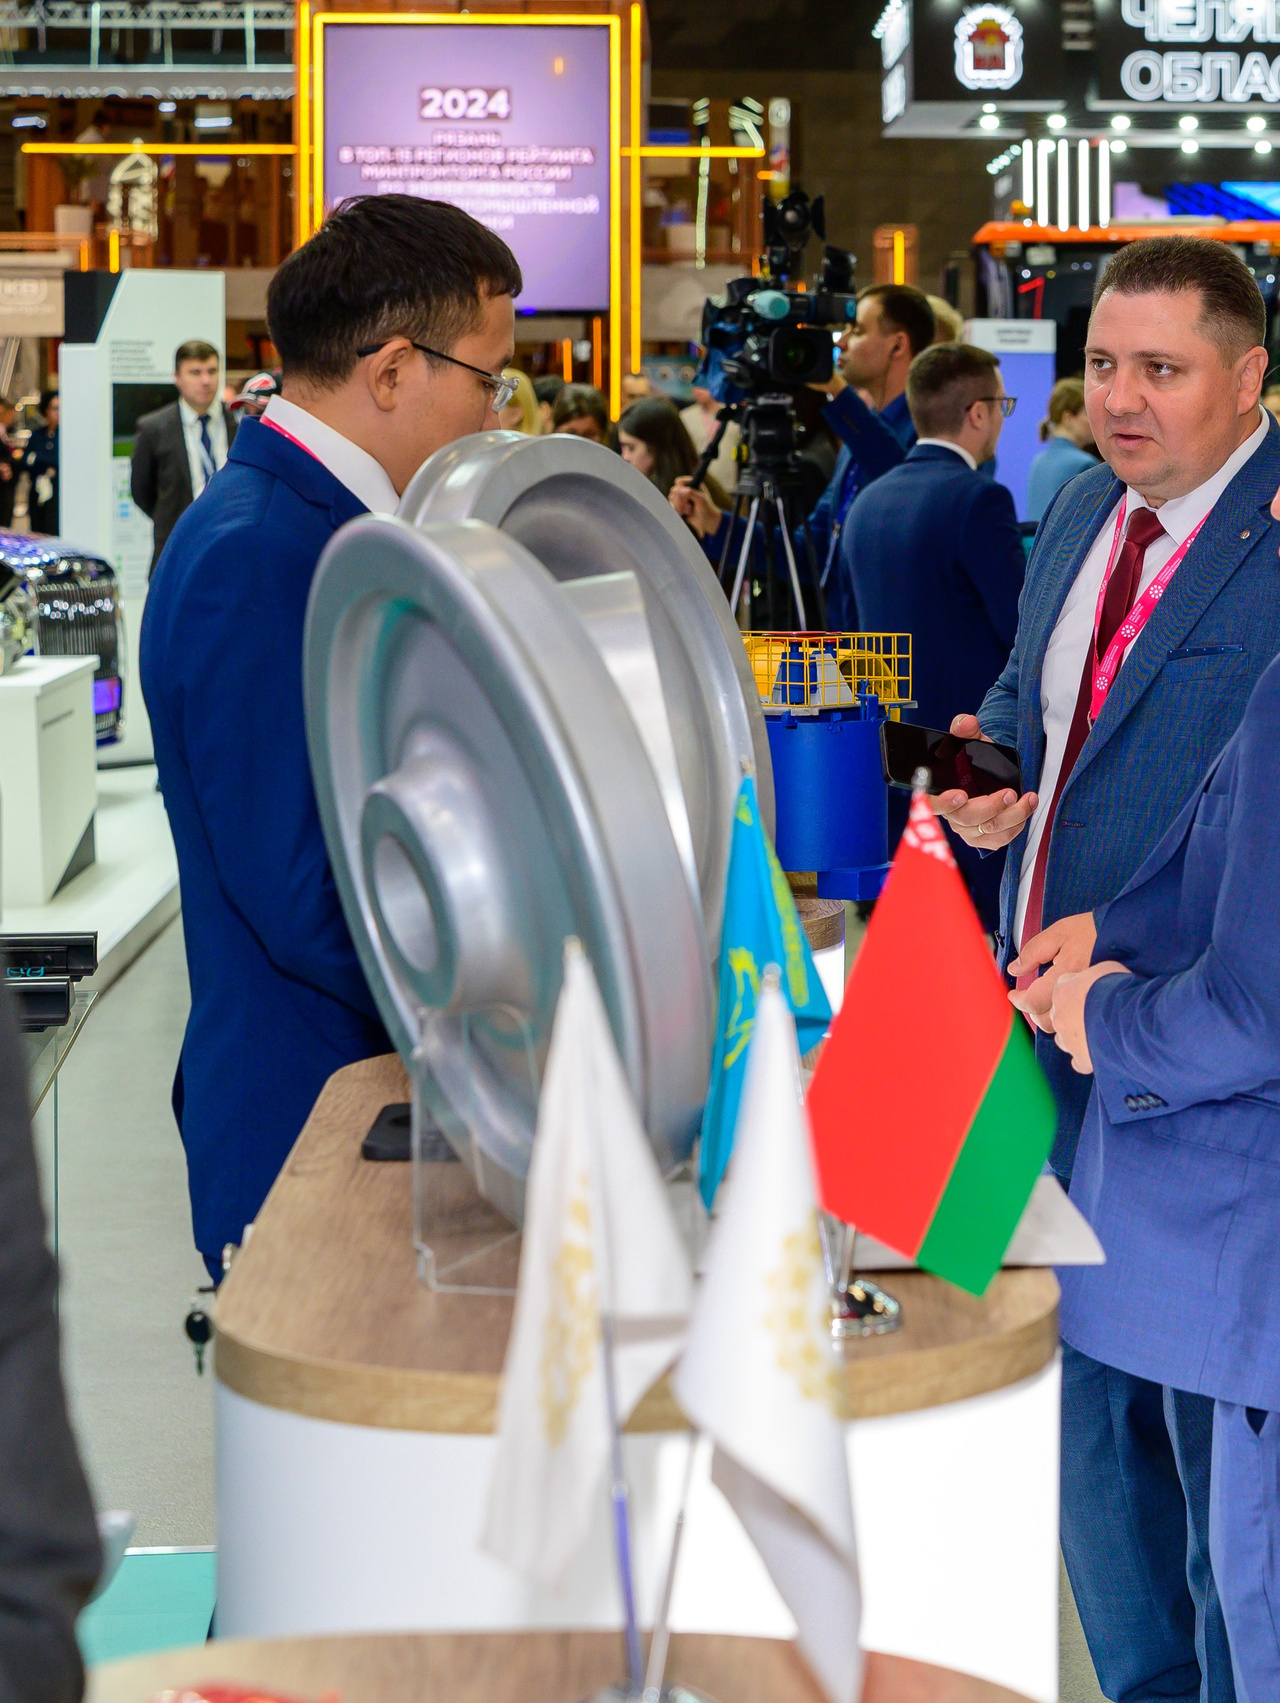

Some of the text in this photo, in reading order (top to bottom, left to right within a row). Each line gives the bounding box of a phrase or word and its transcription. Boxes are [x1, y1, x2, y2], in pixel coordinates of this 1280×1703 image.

[420, 88, 511, 119] 2024
[414, 147, 505, 164] РЕГИОНОВ
[506, 144, 594, 165] РЕЙТИНГА
[501, 164, 571, 180] РОССИИ
